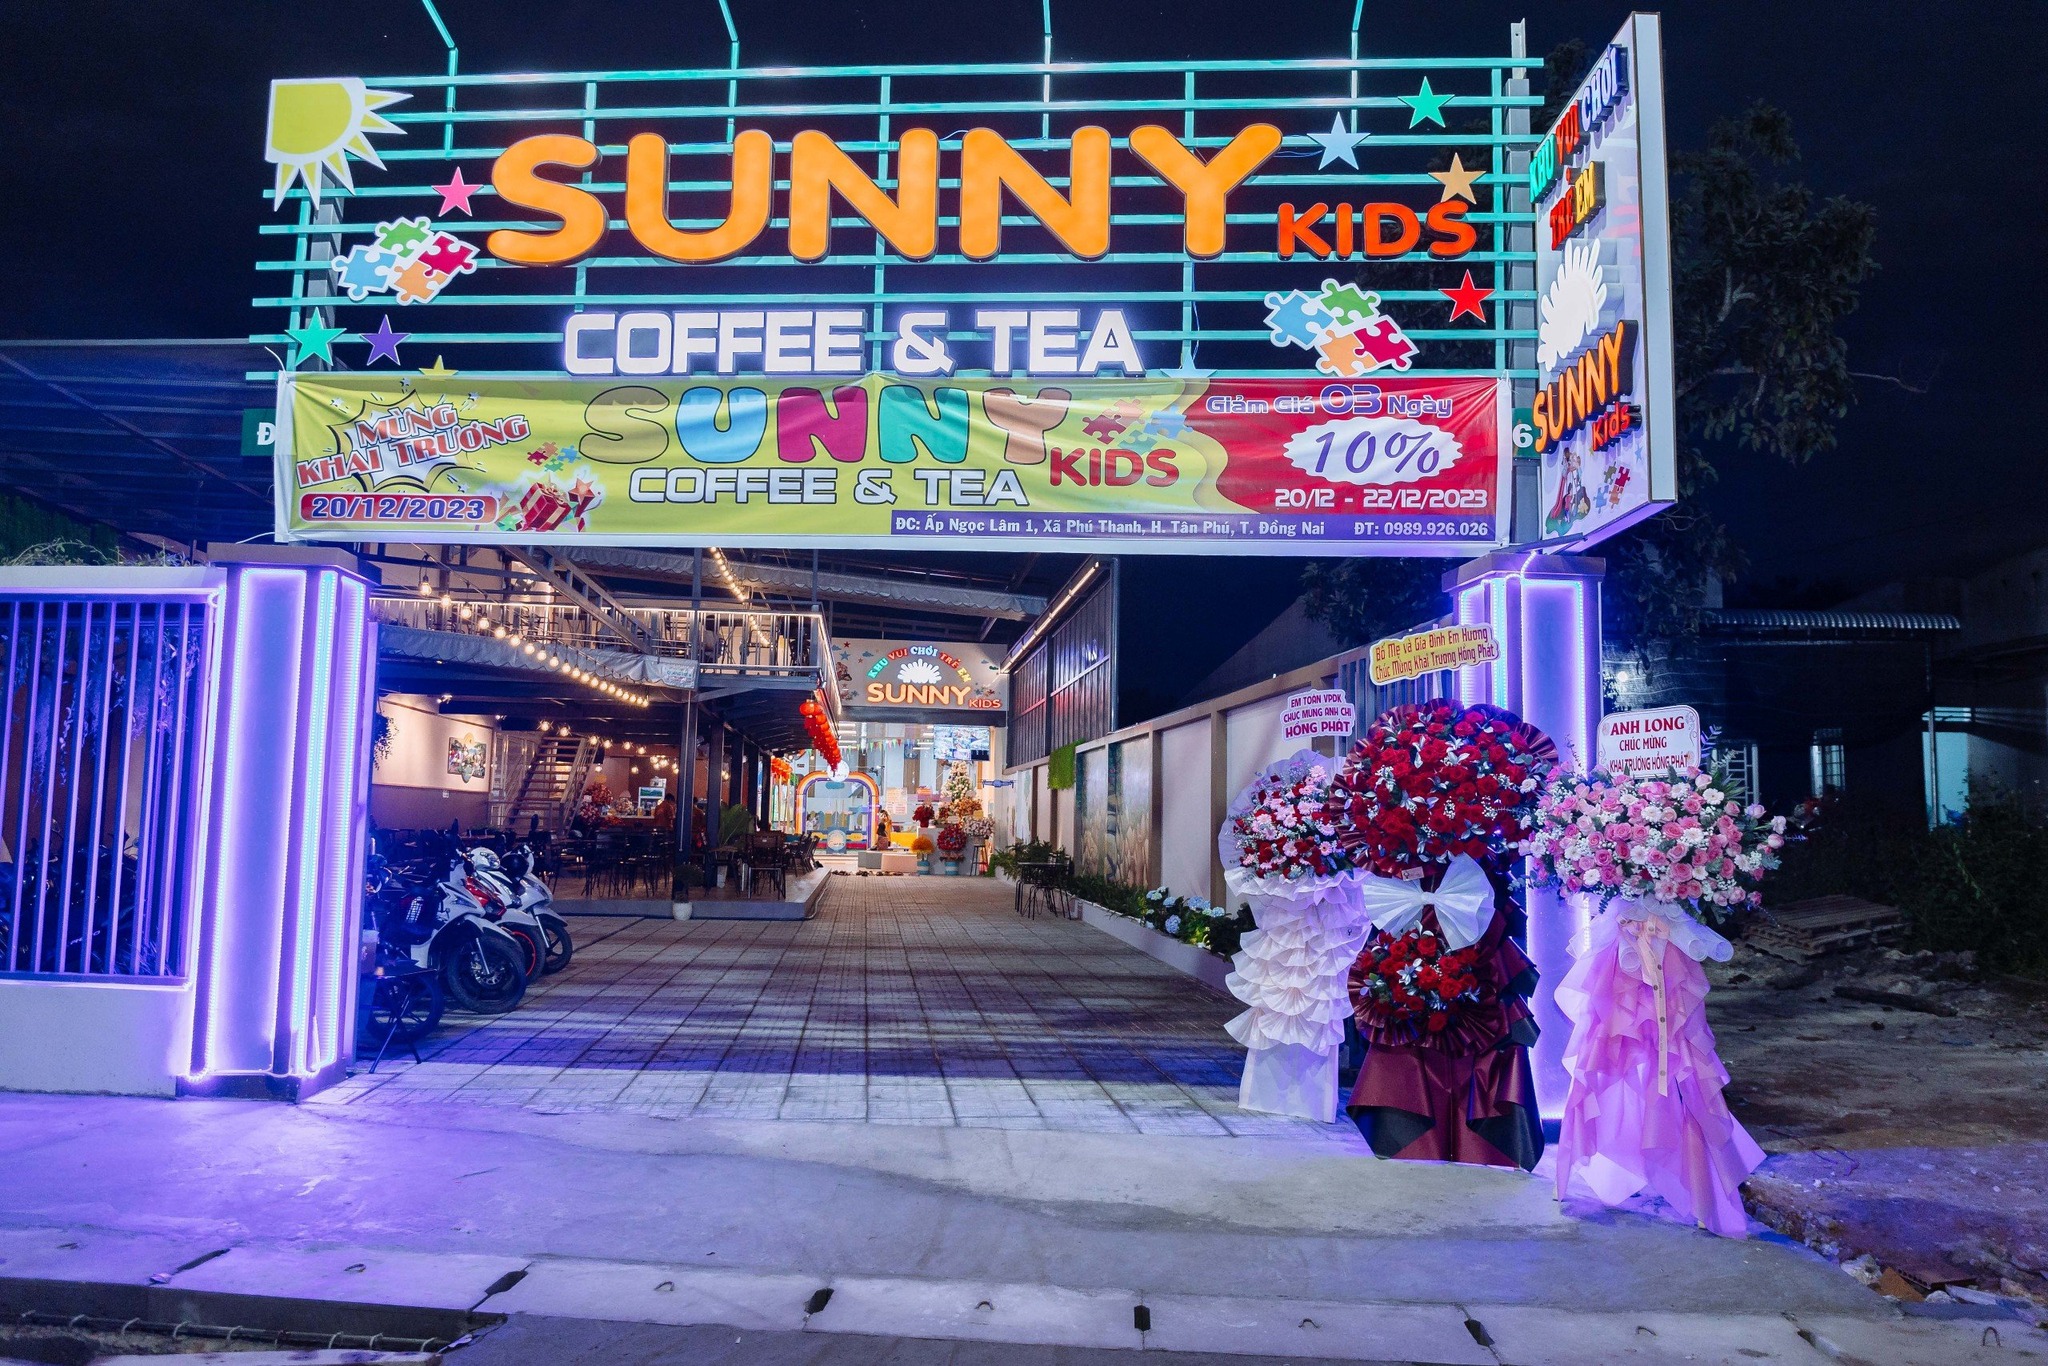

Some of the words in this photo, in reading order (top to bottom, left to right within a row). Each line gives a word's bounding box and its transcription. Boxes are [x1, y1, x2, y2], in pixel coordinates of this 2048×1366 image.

[487, 123, 1283, 266] SUNNY
[1575, 161, 1596, 223] EM
[1277, 200, 1479, 260] KIDS
[563, 309, 865, 375] COFFEE
[893, 309, 957, 375] &
[976, 308, 1145, 375] TEA
[1206, 395, 1269, 414] Giảm
[1274, 395, 1316, 414] Giá
[1319, 384, 1382, 417] 03
[1388, 395, 1453, 419] Ngày
[1532, 320, 1627, 453] SUNNY
[578, 384, 1073, 466] SUNNY
[1592, 402, 1631, 451] Kids
[297, 446, 384, 488] KHAI
[389, 415, 531, 467] TRƯƠNG
[1050, 447, 1180, 487] KIDS
[1314, 430, 1440, 474] 10%
[629, 468, 838, 504] COFFEE
[854, 468, 898, 505] &
[914, 469, 1030, 507] TEA
[1274, 489, 1335, 509] 20/12
[1363, 489, 1489, 510] 22/12/2023
[311, 496, 486, 520] 20/12/2023
[896, 517, 920, 531] ĐC:
[925, 512, 944, 532] Ấp
[949, 518, 985, 533] Ngọc
[990, 518, 1020, 532] Lâm
[1025, 519, 1038, 535] 1,
[1043, 518, 1061, 533] Xã
[1066, 519, 1093, 533] Phú
[1098, 519, 1146, 536] Thanh,
[1151, 520, 1166, 534] H.
[1171, 520, 1198, 534] Tân
[1203, 520, 1235, 537] Phú,
[1240, 521, 1254, 535] T.
[1259, 519, 1296, 537] Đồng
[1301, 521, 1325, 535] Nai
[1354, 521, 1379, 536] ĐT:
[1384, 522, 1488, 536] 0989.926.026
[1448, 631, 1460, 645] Em
[867, 657, 889, 679] KHU
[888, 647, 909, 660] VUI
[957, 667, 971, 683] EM
[1414, 653, 1430, 669] Khai
[1478, 642, 1495, 660] Phát
[867, 682, 971, 706] SUNNY
[968, 699, 1001, 708] KIDS
[1291, 697, 1301, 708] EM
[1321, 718, 1350, 732] PHÁT
[1325, 707, 1338, 717] ANH
[1610, 720, 1640, 736] ANH
[1644, 716, 1684, 733] LONG
[1619, 736, 1640, 751] CHÚC
